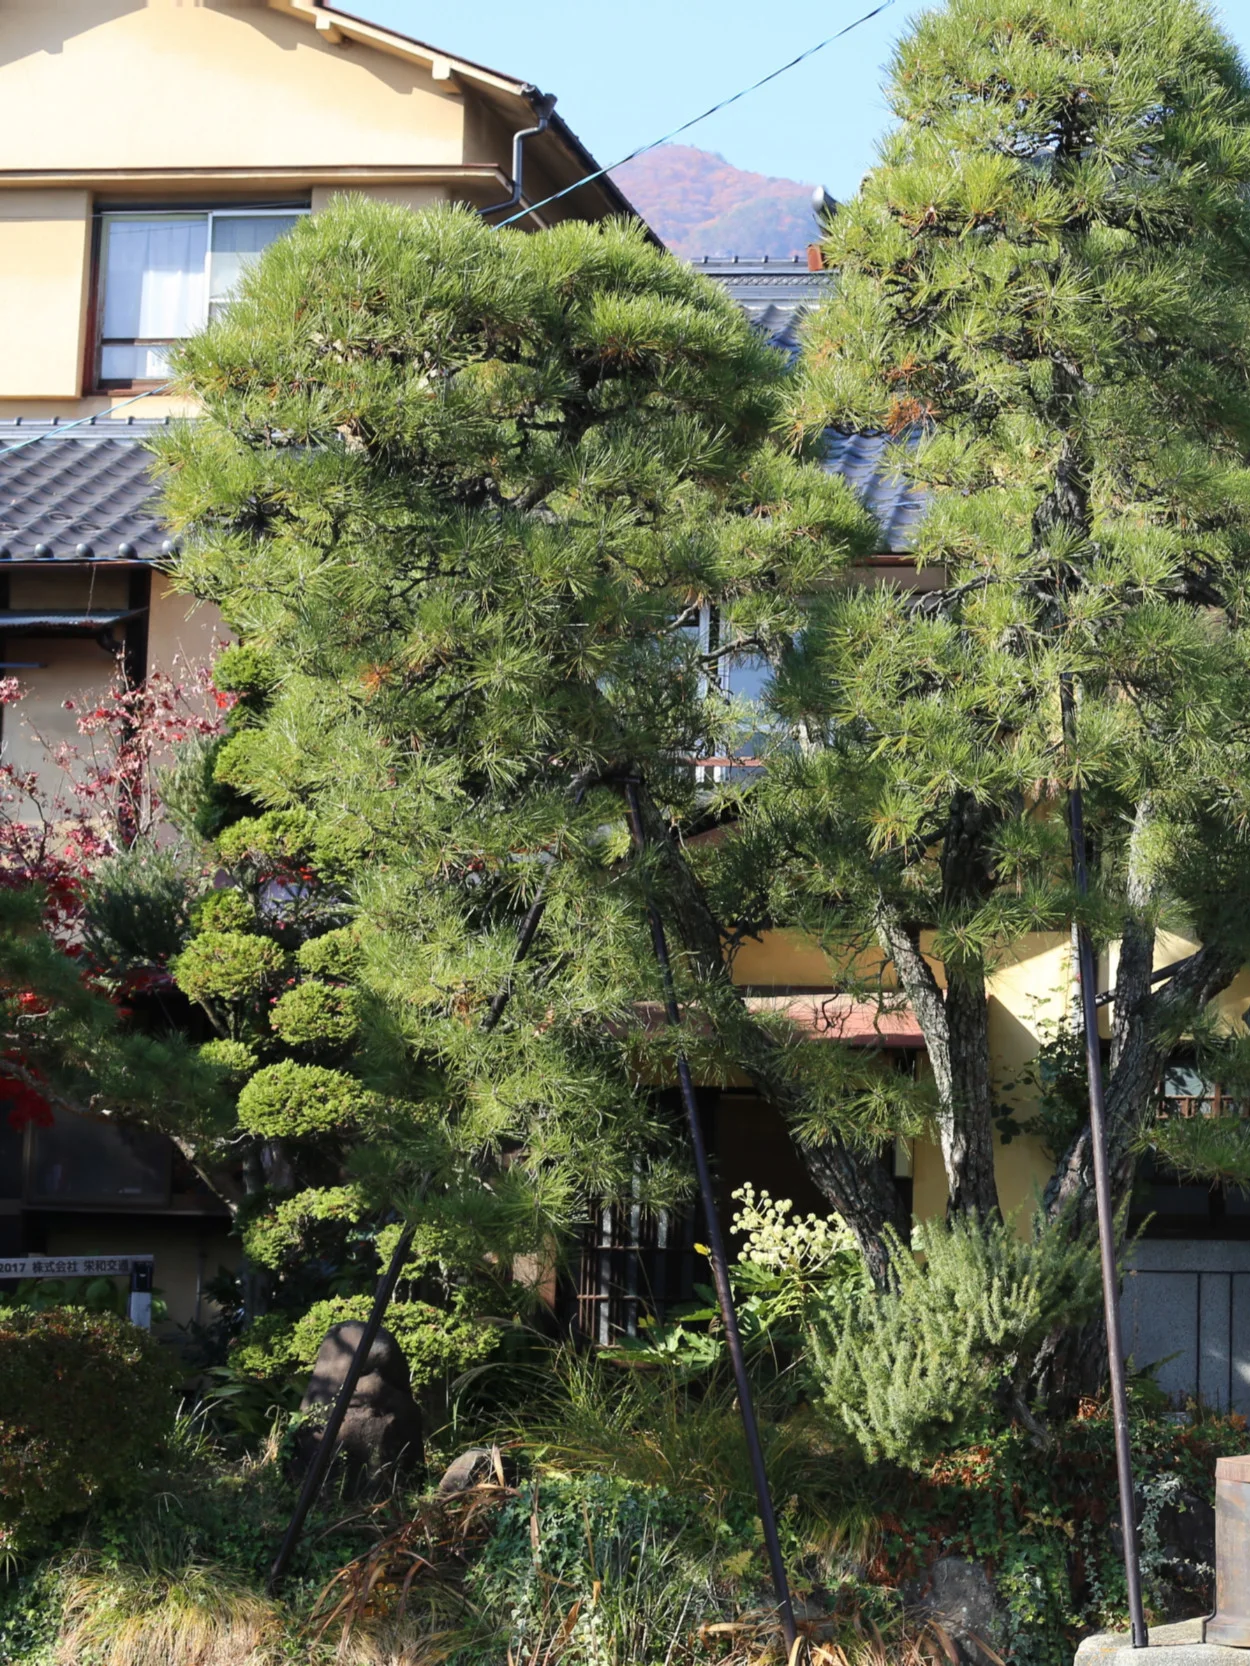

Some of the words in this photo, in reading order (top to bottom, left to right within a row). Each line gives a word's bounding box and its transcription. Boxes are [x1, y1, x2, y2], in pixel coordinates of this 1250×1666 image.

[0, 1263, 26, 1273] 2017
[32, 1261, 78, 1273] 株式会社
[83, 1260, 129, 1272] 栄和交通
